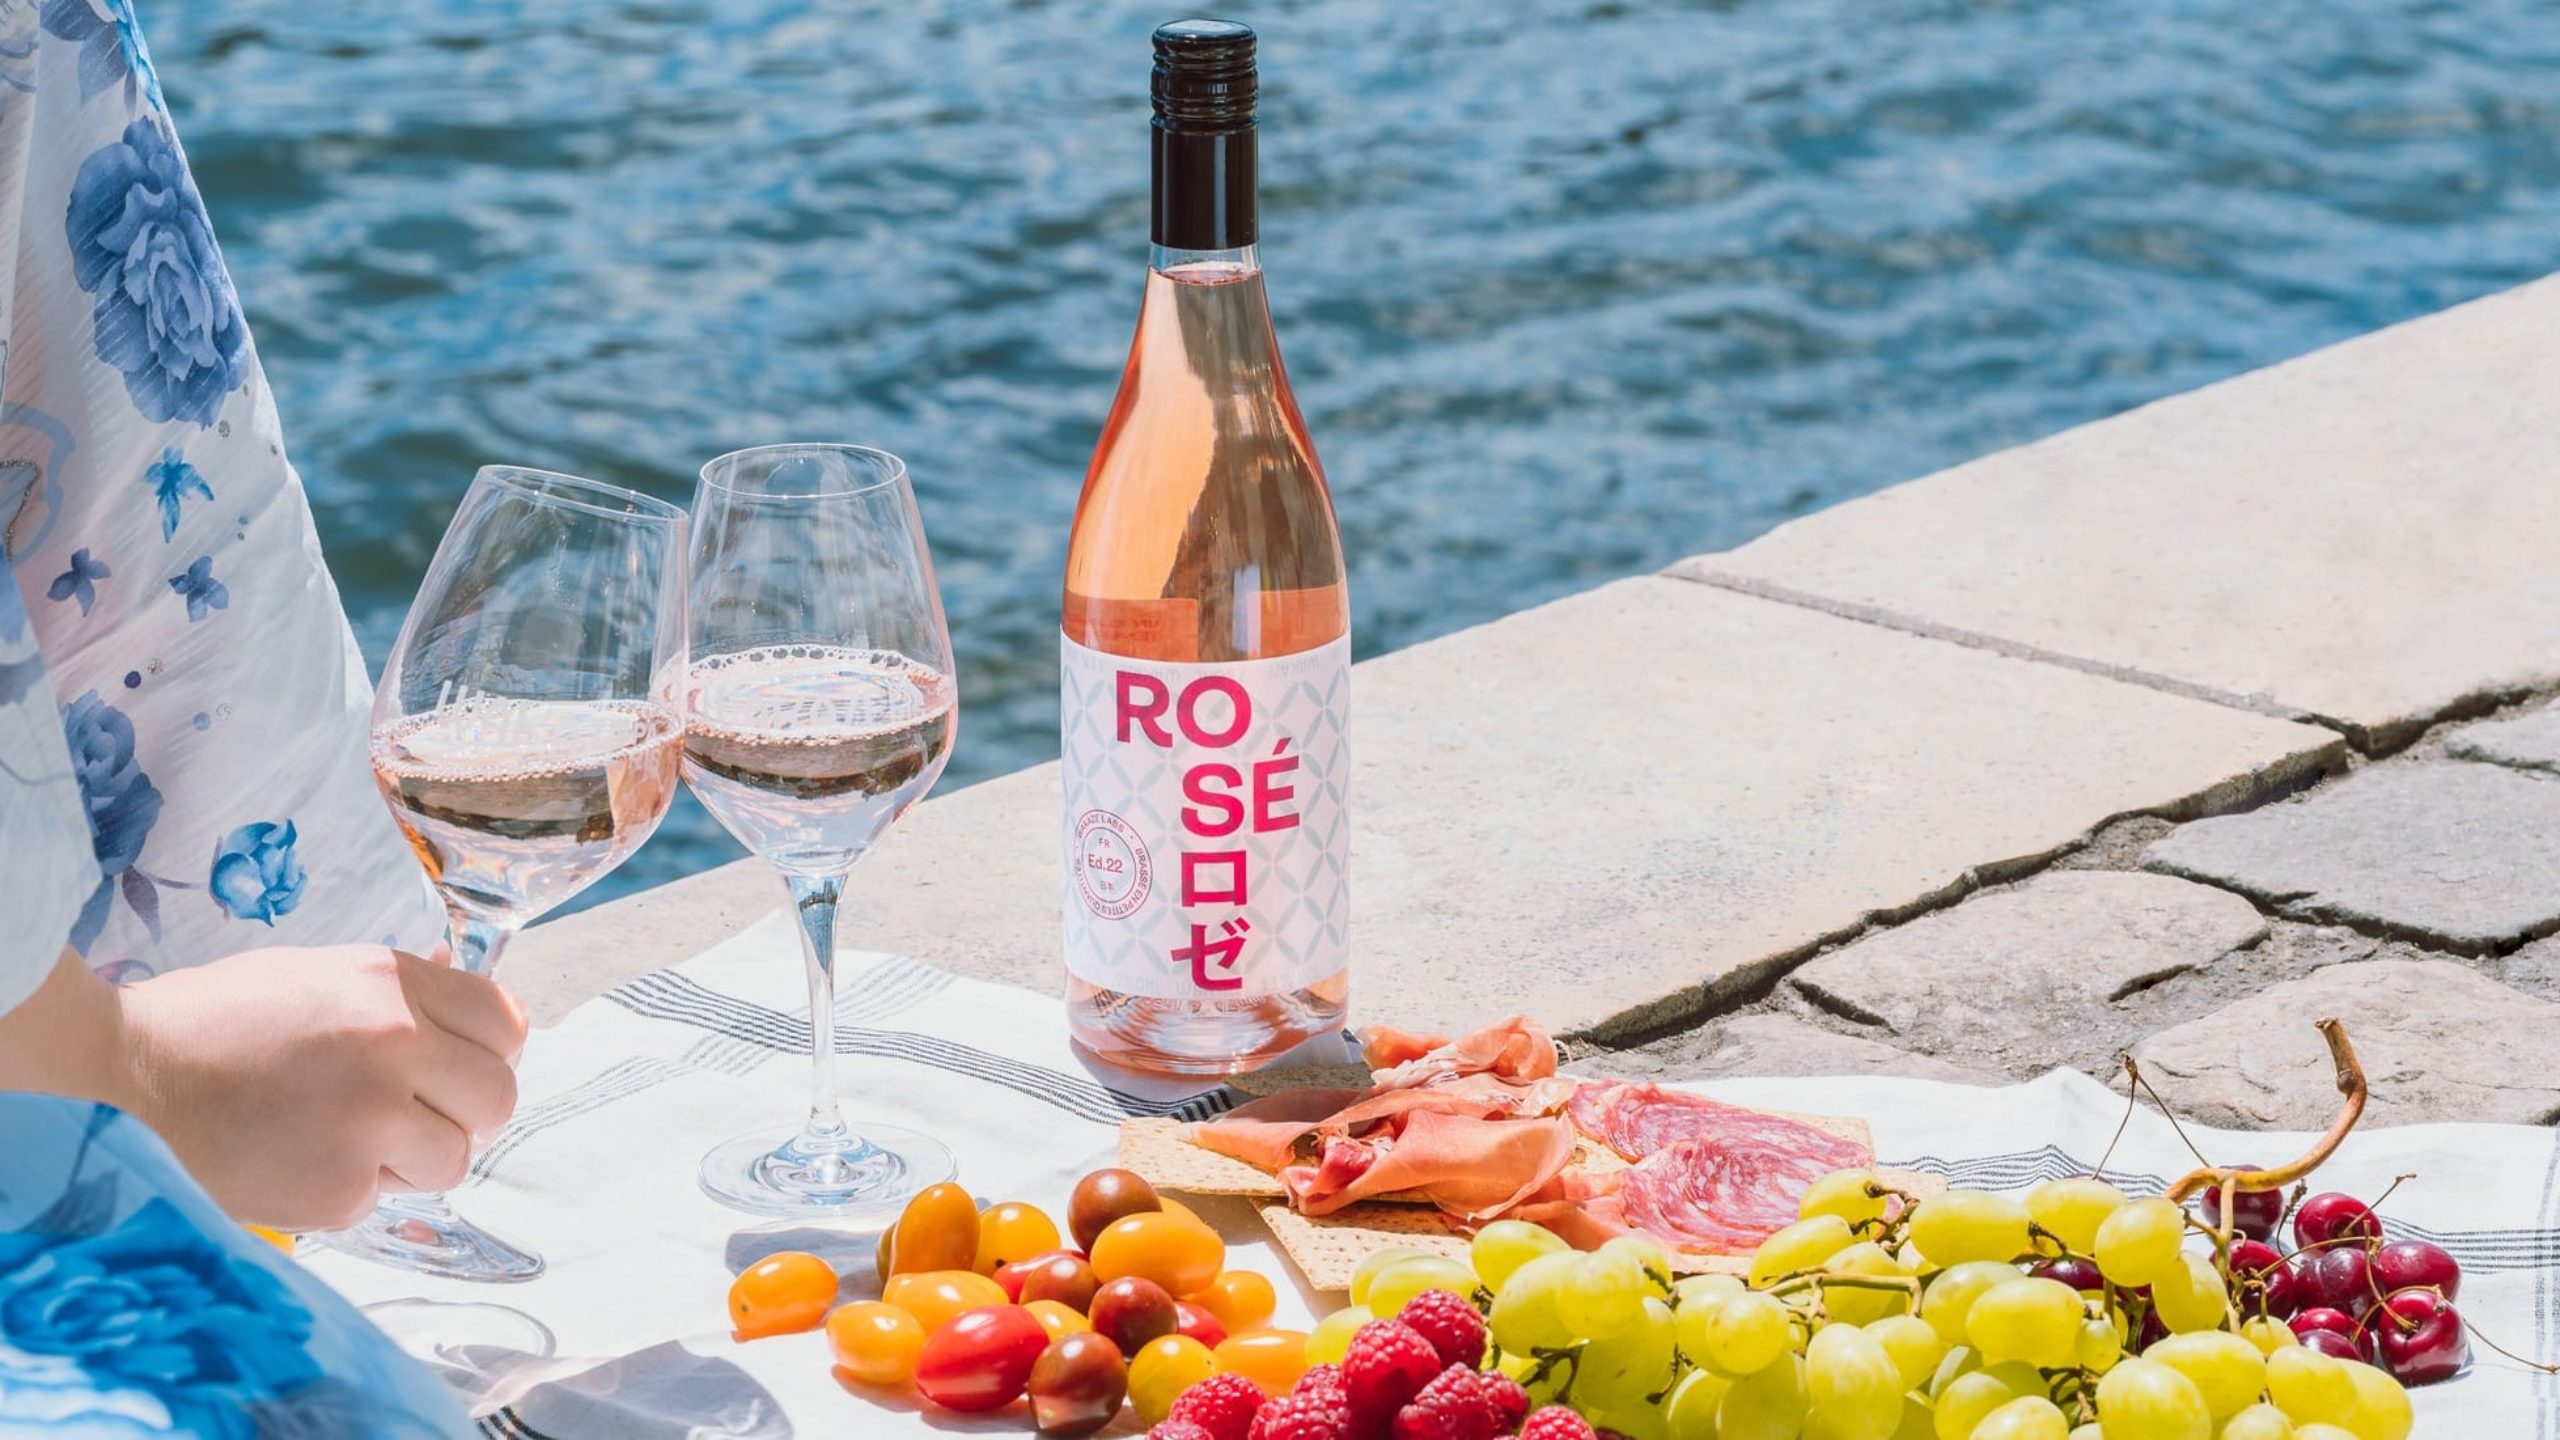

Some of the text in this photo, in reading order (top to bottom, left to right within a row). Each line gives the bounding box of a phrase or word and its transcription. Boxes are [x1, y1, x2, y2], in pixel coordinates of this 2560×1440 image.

[1116, 671, 1252, 749] RO
[1181, 738, 1299, 838] SÉ
[1101, 815, 1125, 833] LABS
[1096, 837, 1111, 848] FR
[1088, 853, 1124, 873] Ed.22
[1131, 888, 1144, 903] EN
[1102, 901, 1134, 915] PETITES
